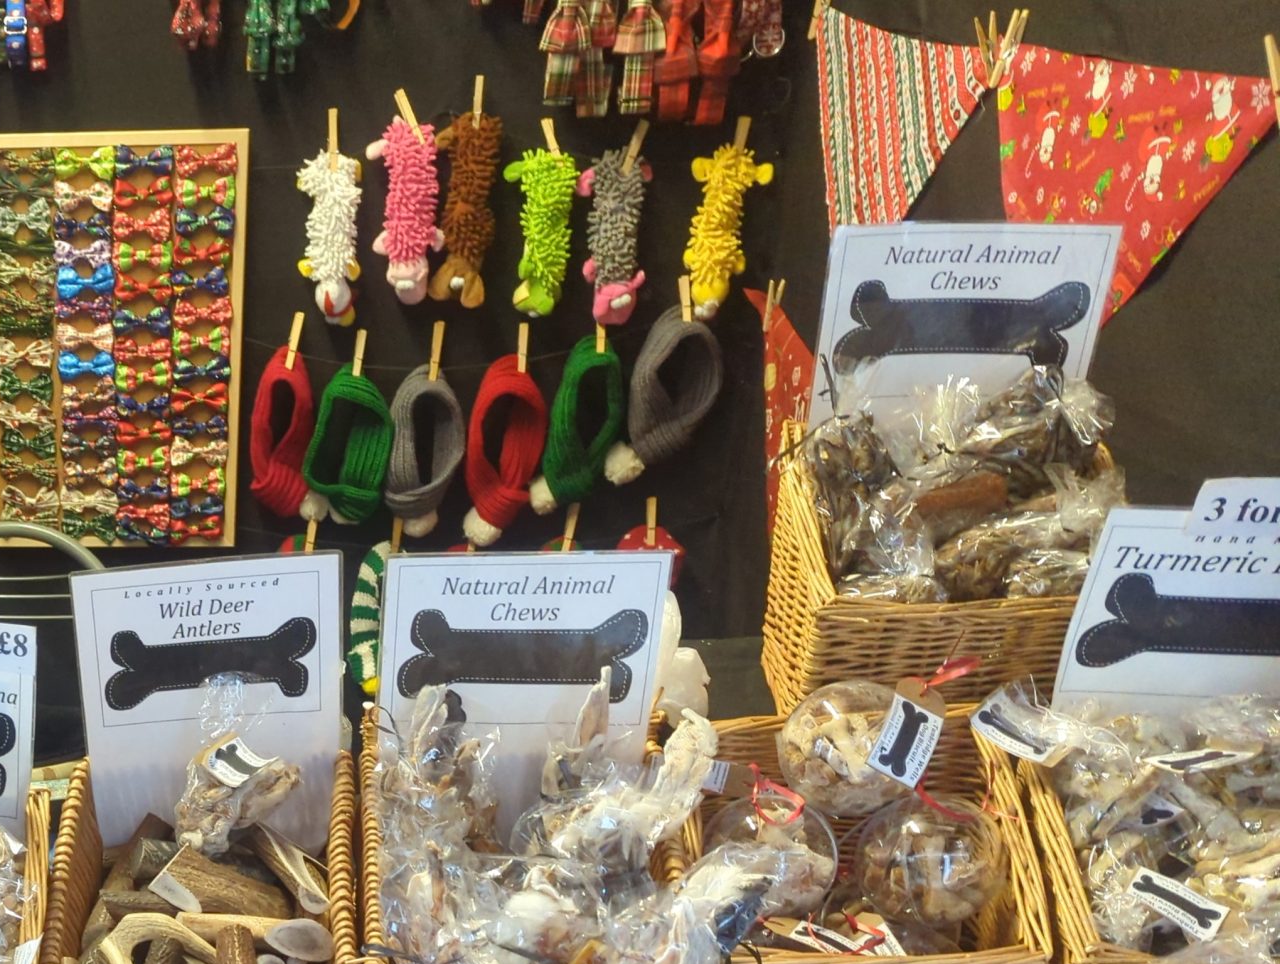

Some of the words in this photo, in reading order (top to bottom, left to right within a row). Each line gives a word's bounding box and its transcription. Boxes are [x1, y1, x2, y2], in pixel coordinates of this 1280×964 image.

[884, 245, 973, 265] Natural
[975, 245, 1062, 265] Animal
[930, 271, 1002, 290] Chews
[1204, 497, 1227, 522] 3
[1114, 546, 1268, 575] Turmeric
[124, 585, 193, 600] Locally
[205, 577, 281, 592] Sourced
[441, 575, 531, 596] Natural
[532, 574, 616, 596] Animal
[159, 600, 203, 620] Wild
[207, 598, 255, 615] Deer
[490, 602, 561, 622] Chews
[172, 619, 242, 640] Antlers
